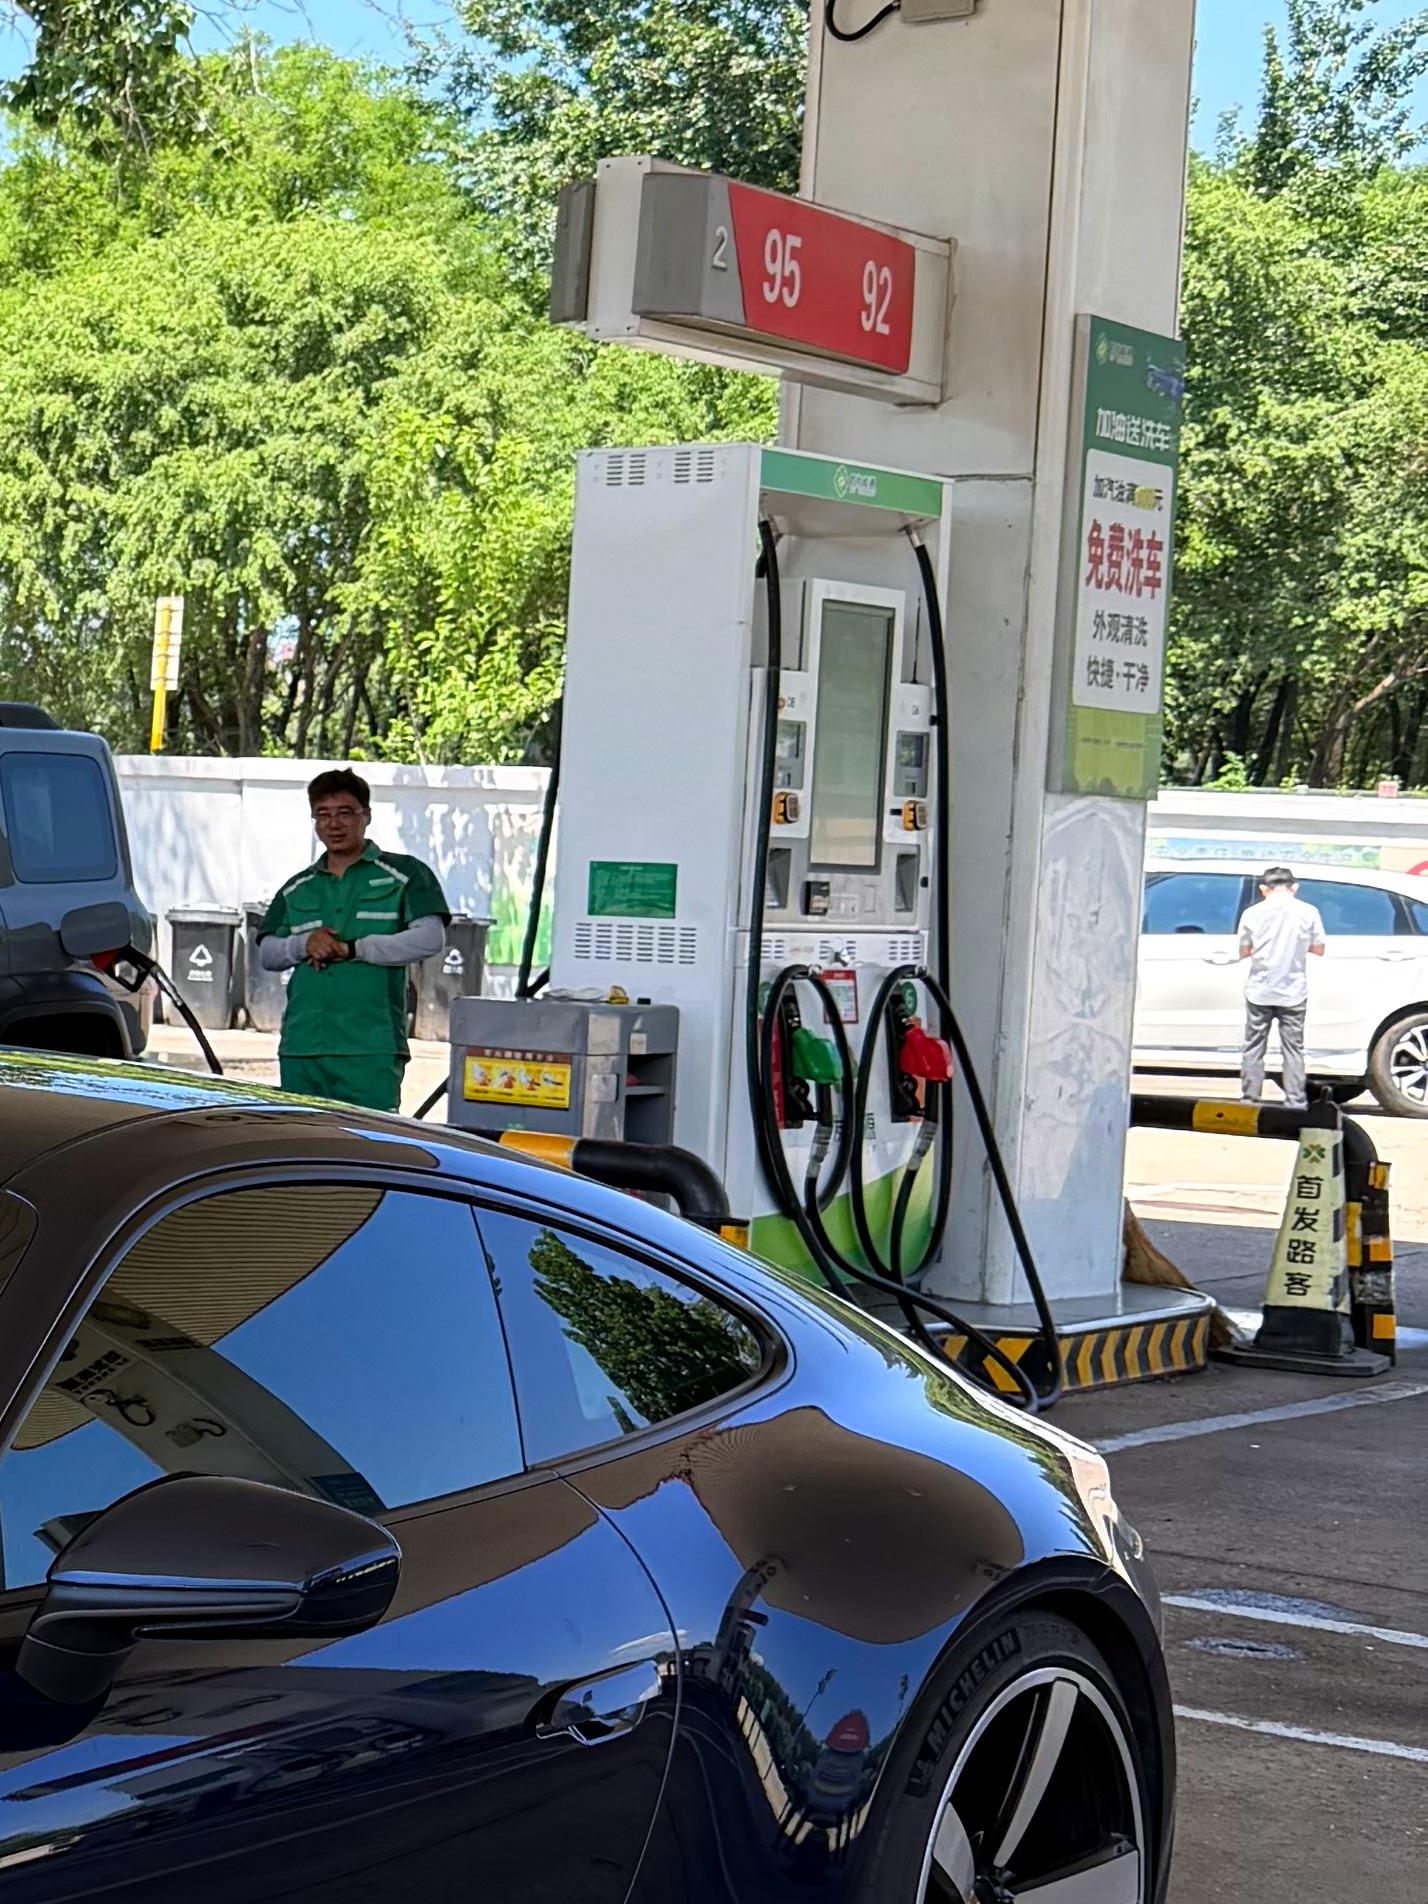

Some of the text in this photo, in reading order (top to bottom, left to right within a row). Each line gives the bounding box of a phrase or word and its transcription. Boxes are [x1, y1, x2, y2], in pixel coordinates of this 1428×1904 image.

[711, 225, 893, 337] 2 95 92
[1095, 406, 1171, 453] 加油送洗车
[1085, 518, 1164, 600] 免费洗车
[1092, 609, 1148, 648] 外观清洗
[1283, 1174, 1325, 1298] 首发路客
[926, 1631, 1018, 1756] MICHELIN
